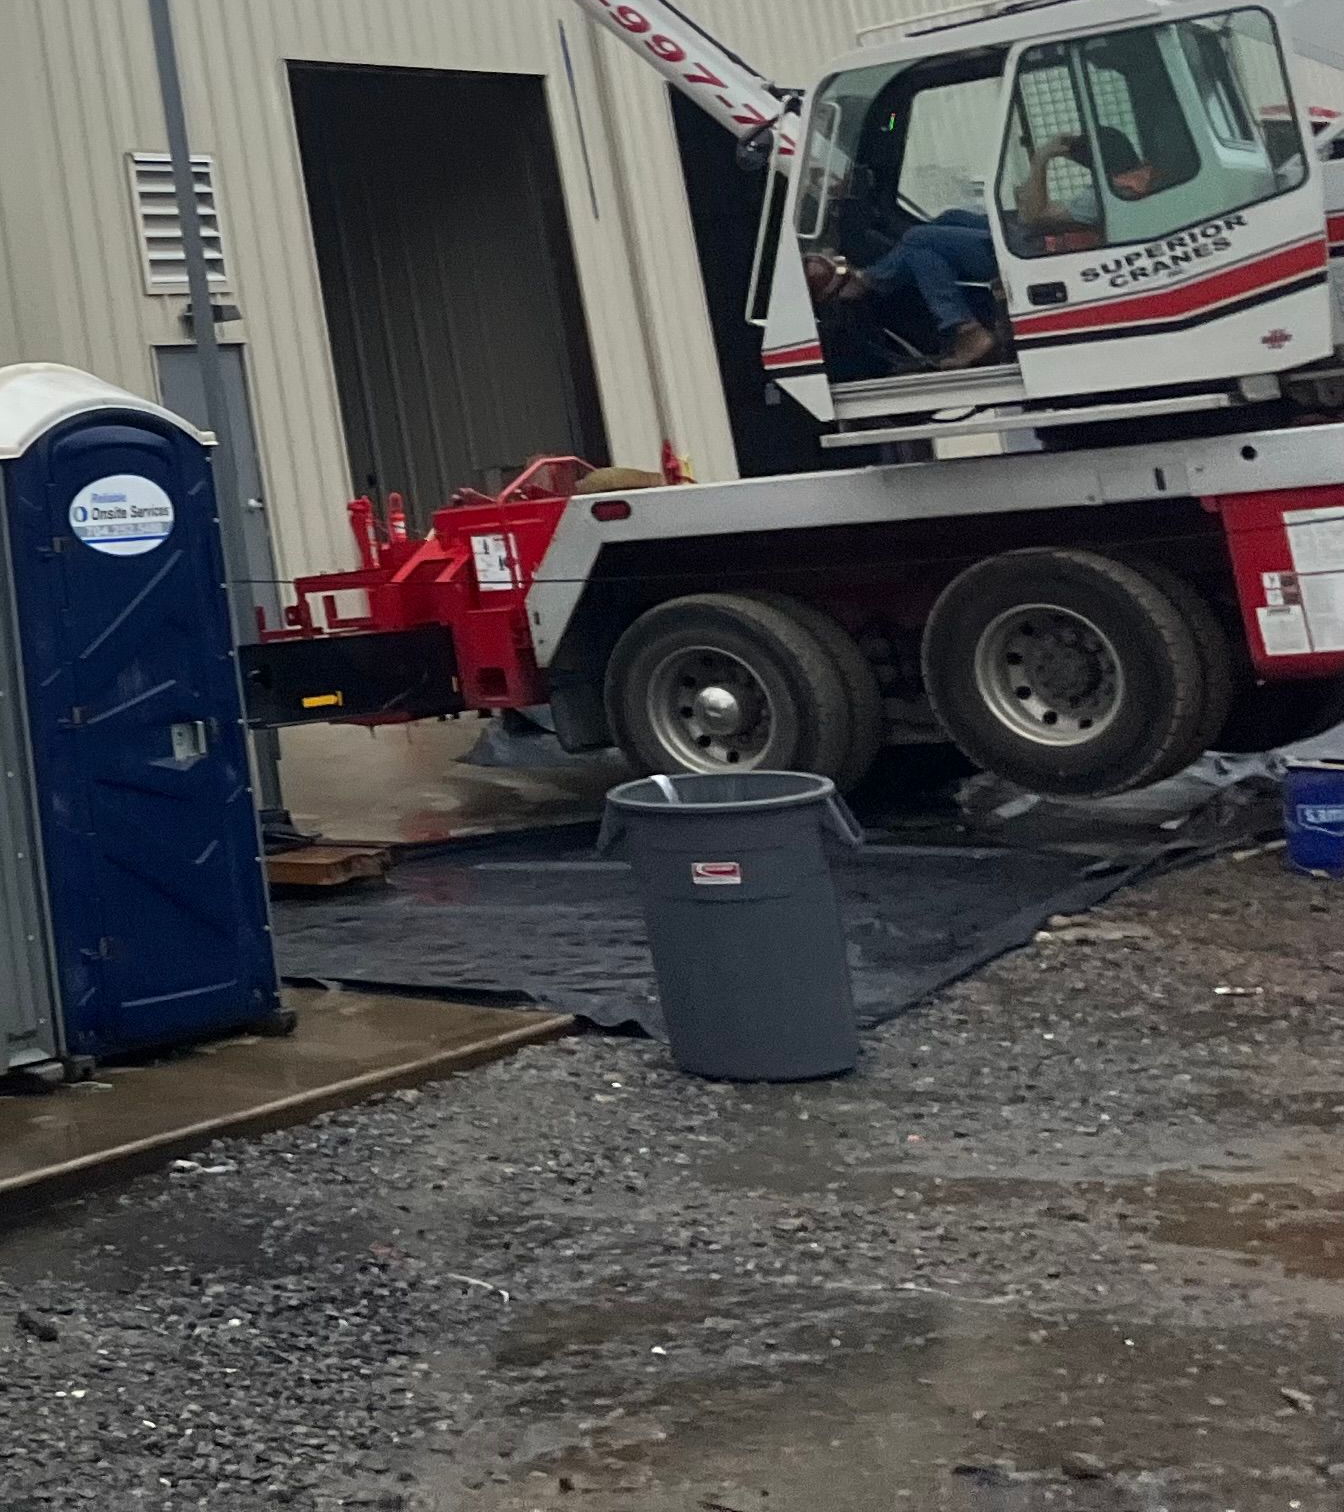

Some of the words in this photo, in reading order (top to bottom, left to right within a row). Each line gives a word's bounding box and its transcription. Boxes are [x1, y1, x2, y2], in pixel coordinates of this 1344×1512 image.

[1079, 214, 1248, 282] SUPERIOR
[1109, 237, 1232, 288] CRANES
[92, 507, 127, 521] Onsite
[130, 505, 169, 519] Services
